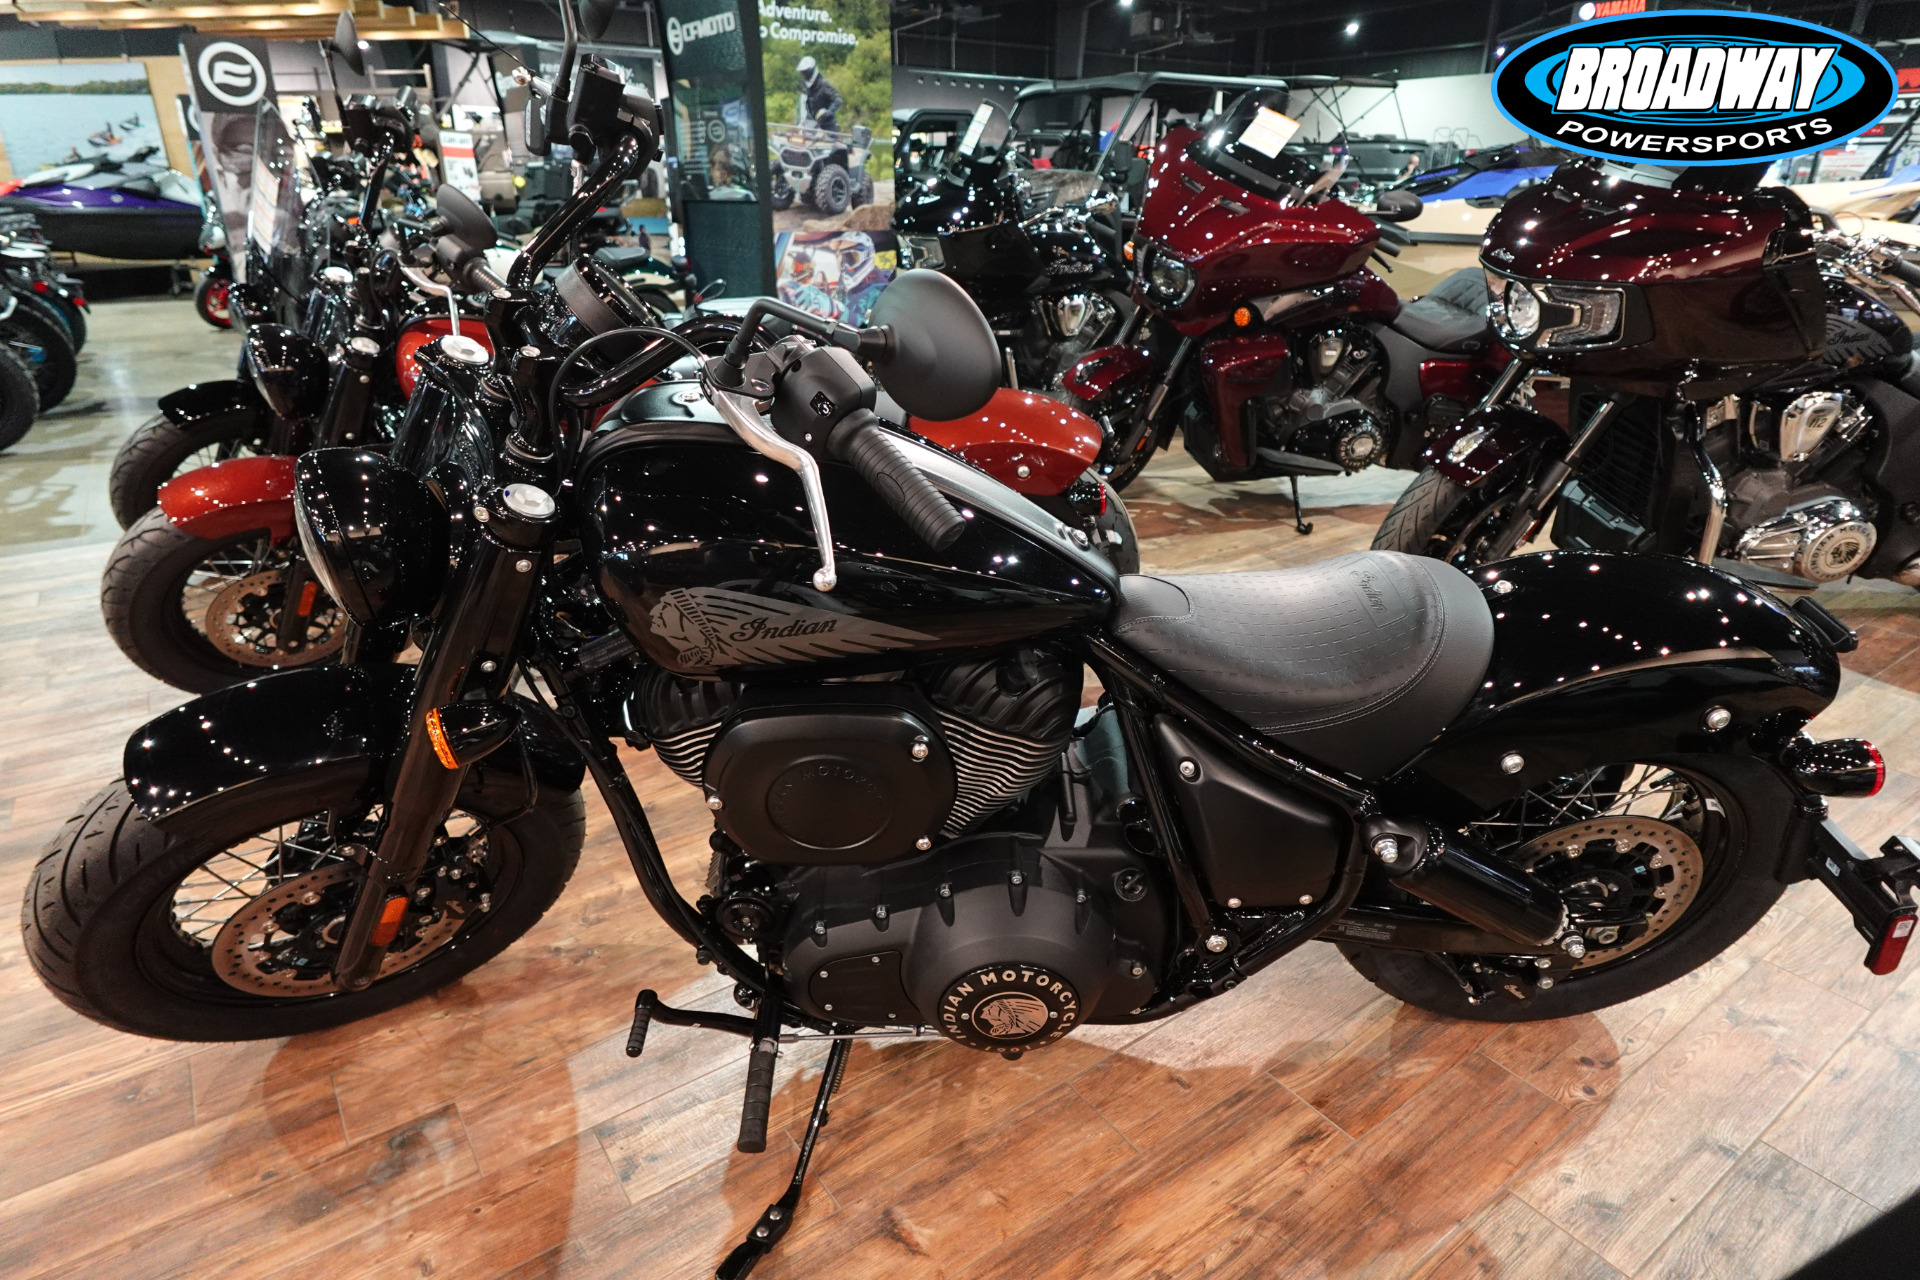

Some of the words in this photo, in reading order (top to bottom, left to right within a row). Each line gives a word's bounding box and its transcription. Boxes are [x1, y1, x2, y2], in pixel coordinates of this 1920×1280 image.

[758, 0, 832, 23] Adventure.
[1595, 0, 1646, 18] YAMAHA
[682, 11, 736, 42] CFMOTO
[769, 22, 859, 46] Compromise.
[730, 616, 838, 642] Indian
[943, 981, 975, 1040] INDIAN
[980, 969, 1077, 1039] MOTORCYCLE
